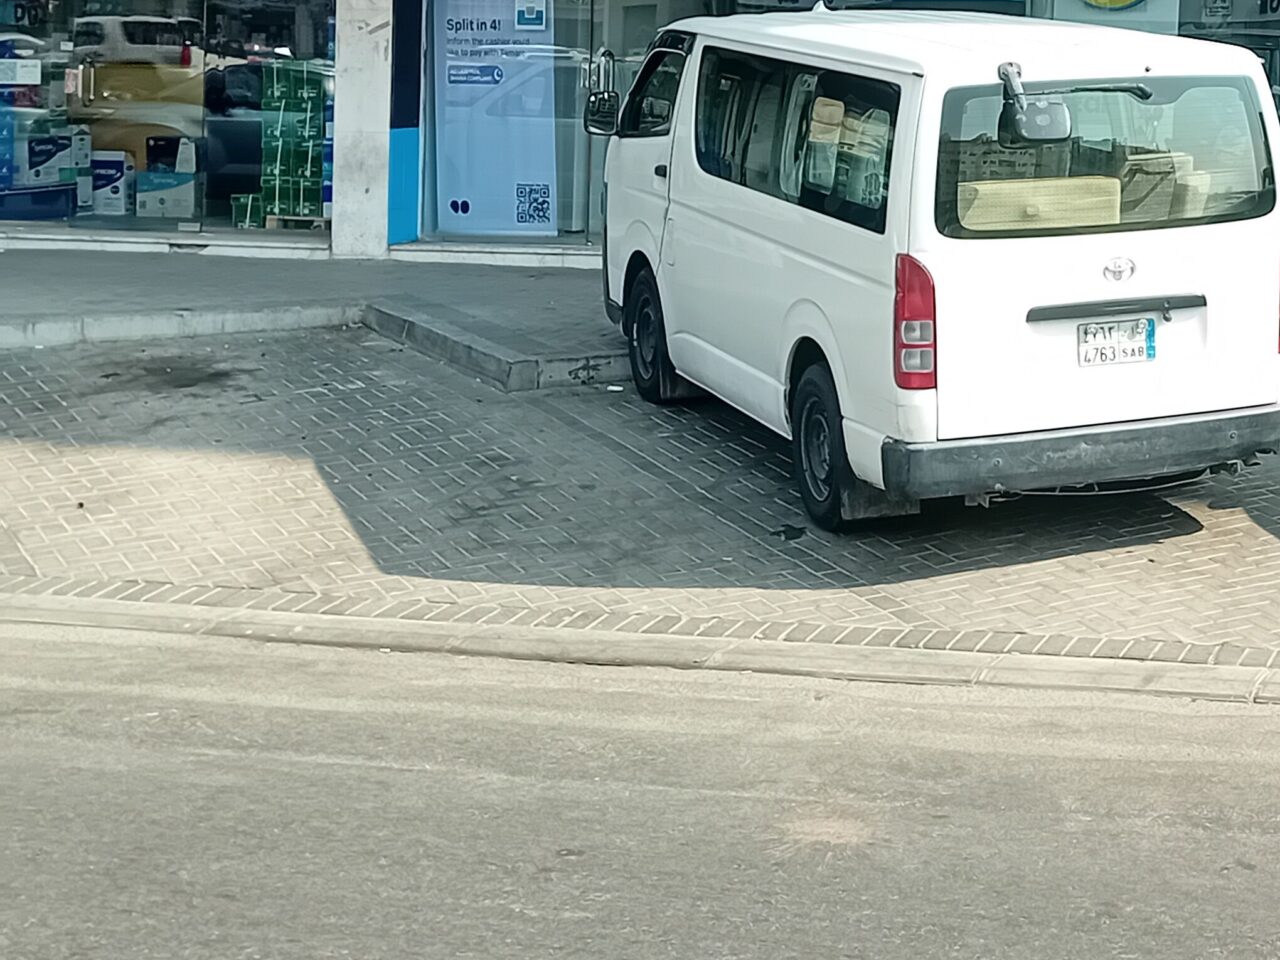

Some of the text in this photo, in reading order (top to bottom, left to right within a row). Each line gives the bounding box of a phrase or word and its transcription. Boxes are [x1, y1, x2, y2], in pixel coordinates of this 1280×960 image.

[446, 18, 475, 33] Split
[477, 19, 487, 31] in
[1084, 346, 1145, 363] 4763 SAB
